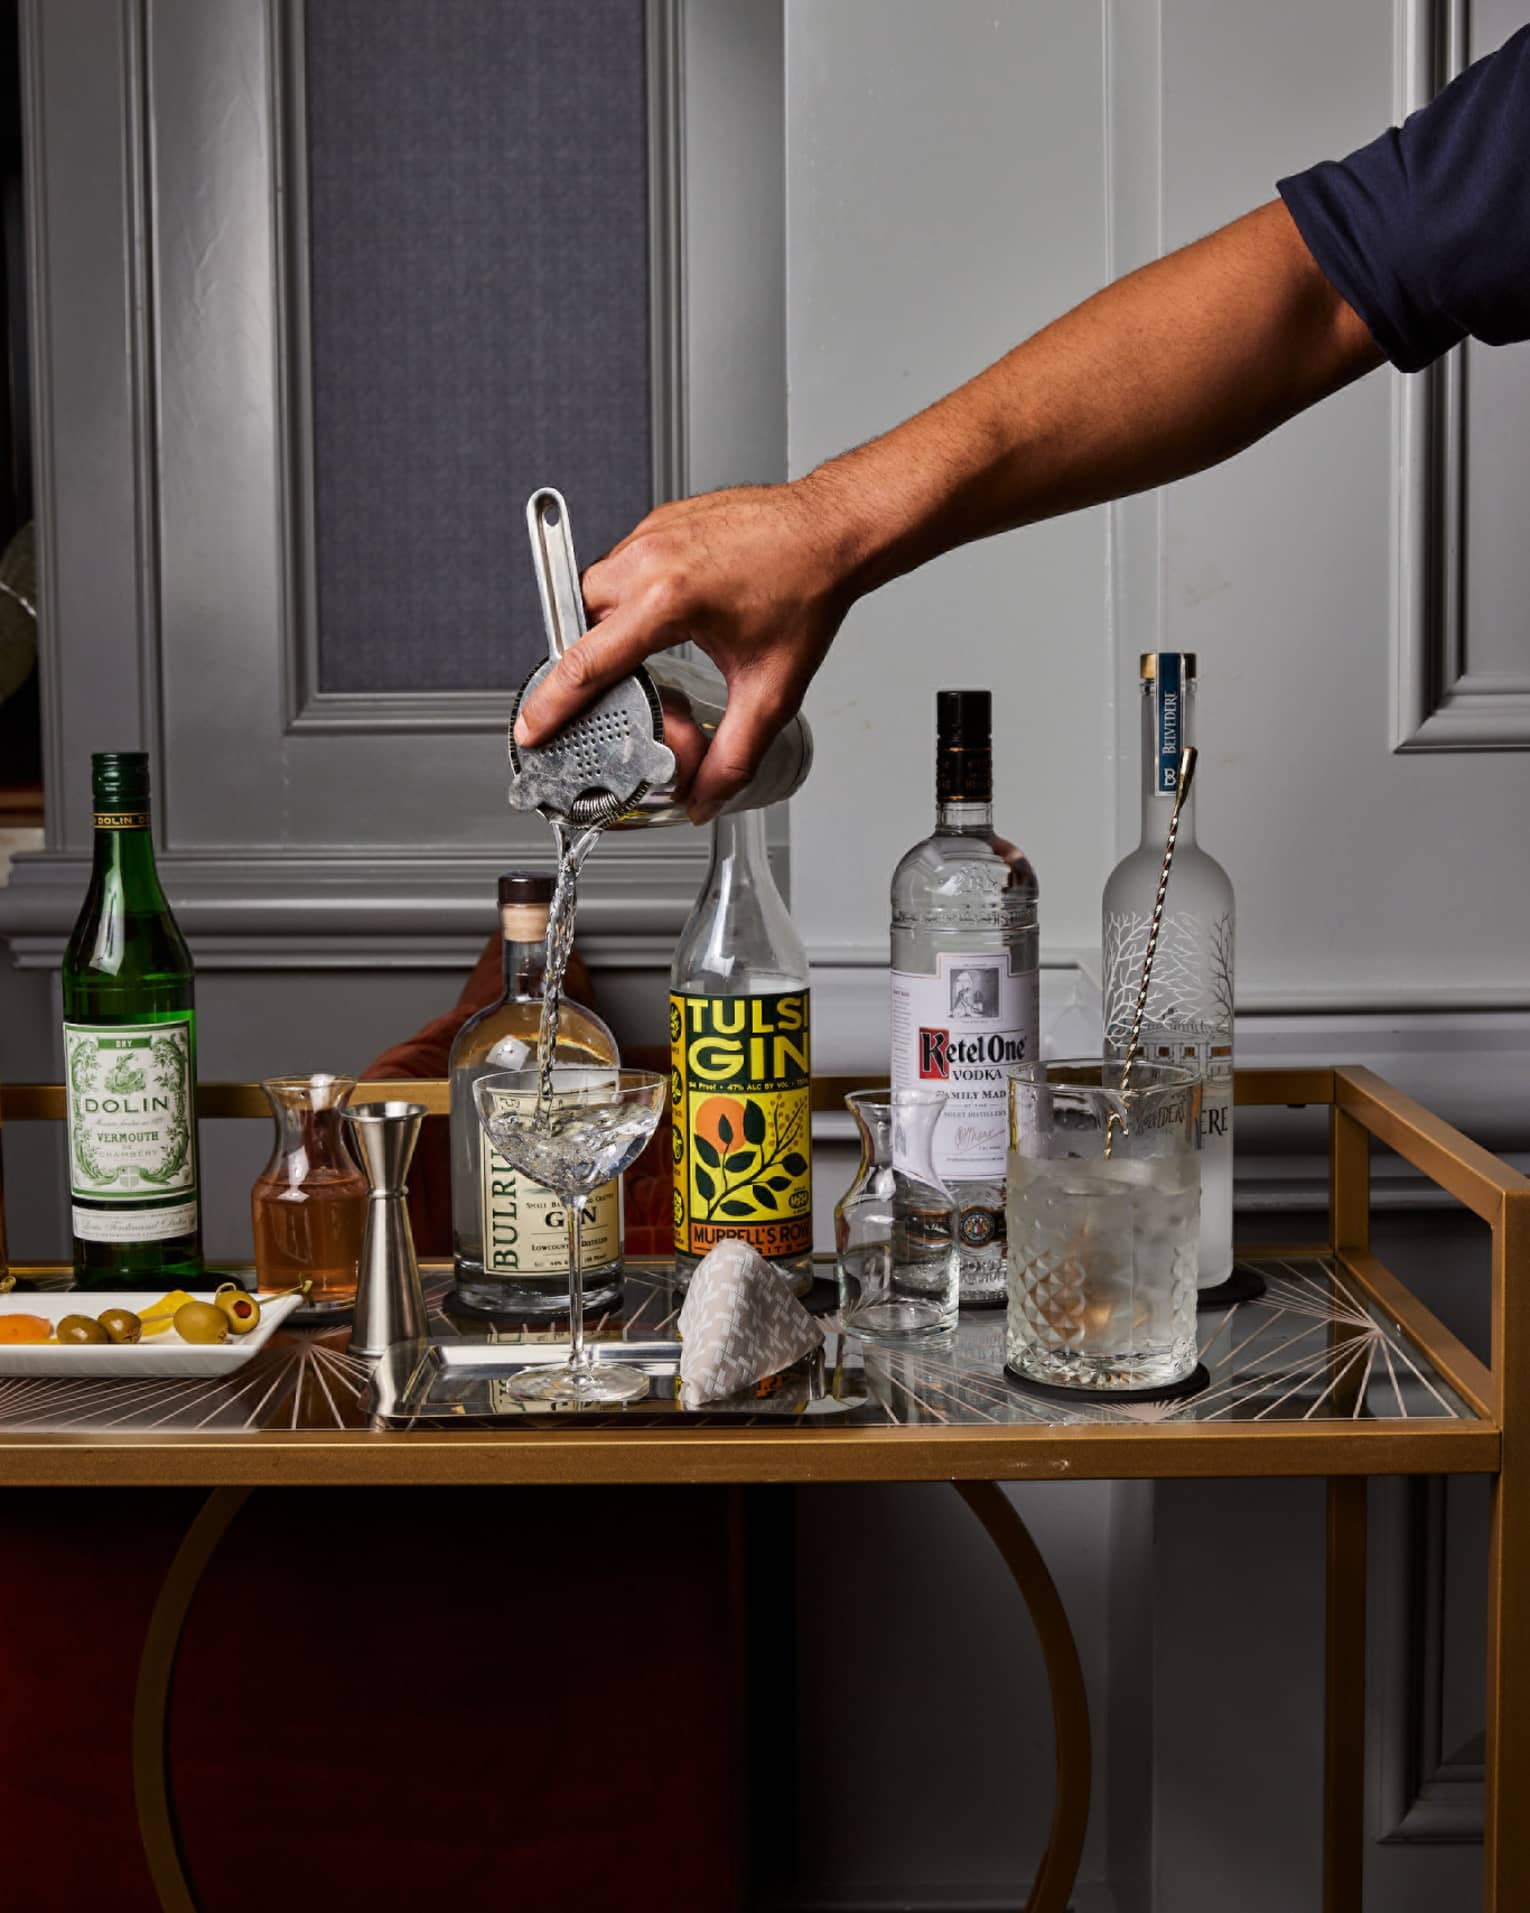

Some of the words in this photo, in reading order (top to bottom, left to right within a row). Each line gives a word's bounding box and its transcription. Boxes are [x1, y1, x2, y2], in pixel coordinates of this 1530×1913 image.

[1162, 691, 1177, 755] BELVEDERE
[97, 816, 133, 825] DOLIN
[687, 994, 808, 1034] TULSI
[115, 1040, 132, 1048] DRY
[688, 1031, 809, 1081] GIN
[921, 1031, 986, 1078] Ketel
[988, 1034, 1025, 1064] One
[952, 1068, 1003, 1081] VODKA
[982, 1089, 1007, 1100] MAD
[85, 1096, 168, 1113] DOLIN
[97, 1131, 159, 1142] VERMOUTH
[545, 1206, 597, 1229] GN
[694, 1226, 776, 1244] MURRELL'S
